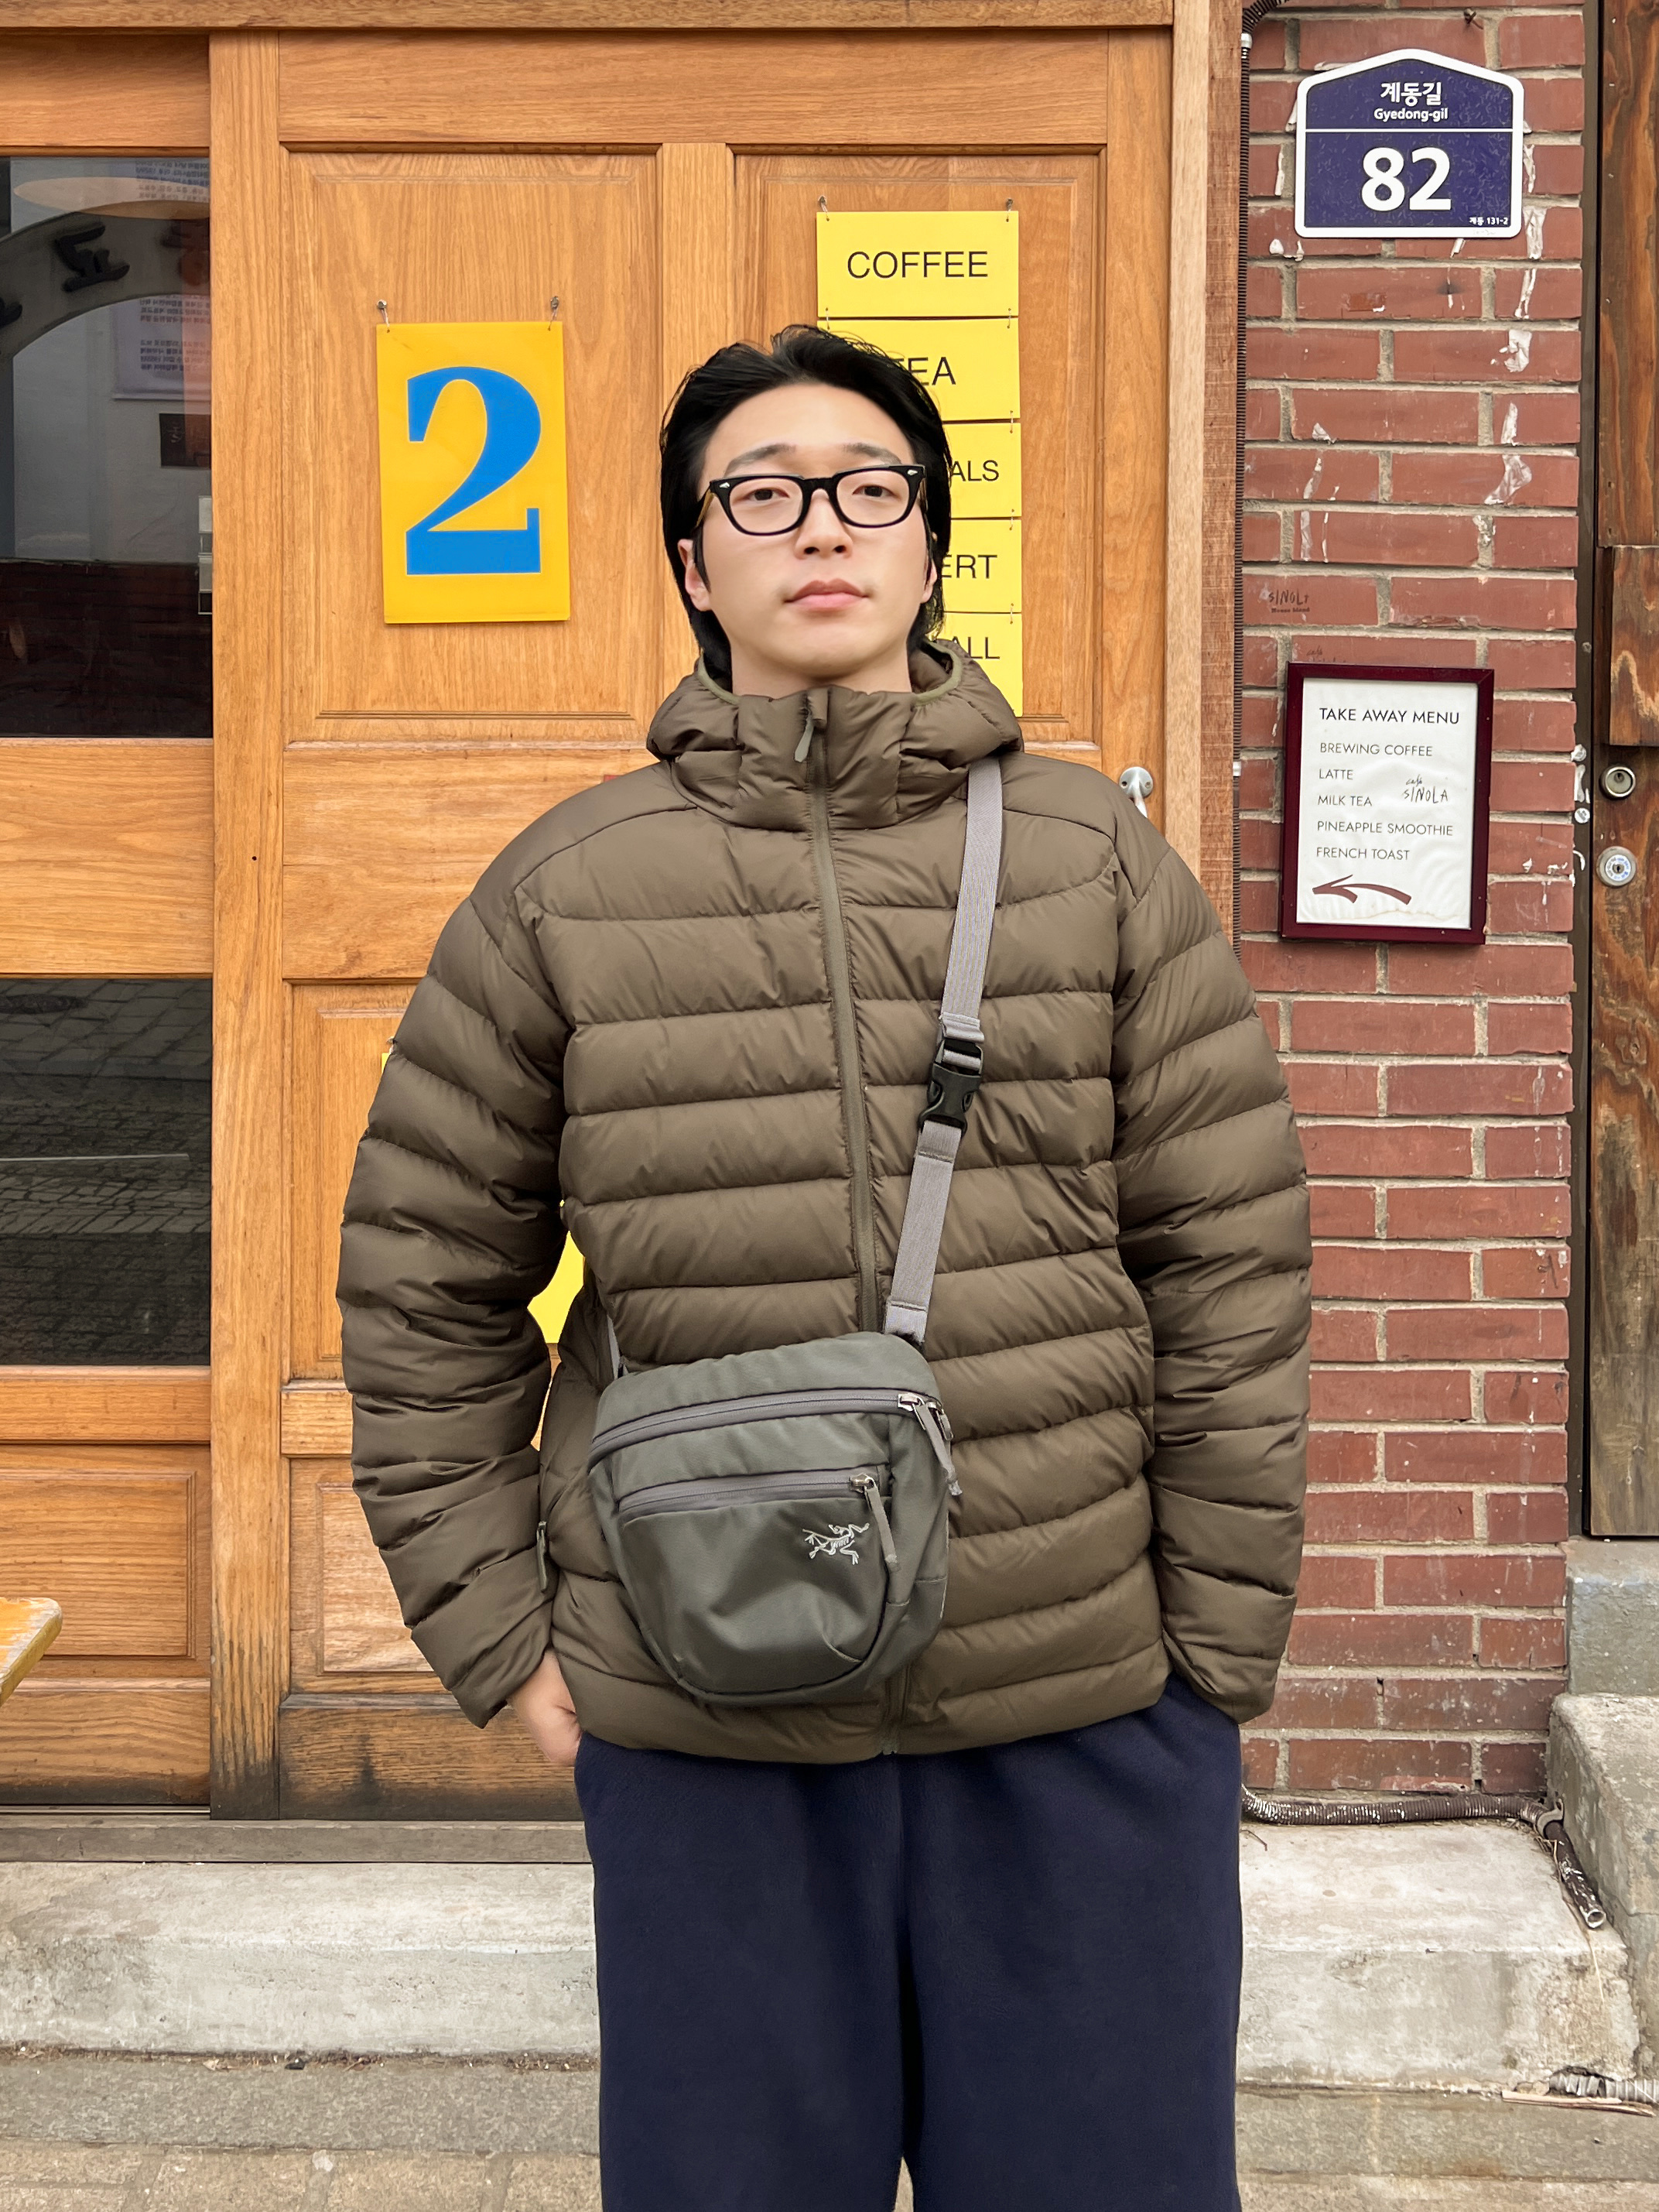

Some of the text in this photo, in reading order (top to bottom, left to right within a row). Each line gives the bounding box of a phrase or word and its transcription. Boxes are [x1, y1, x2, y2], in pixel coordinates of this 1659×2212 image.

[1380, 81, 1442, 106] 계동길
[1373, 108, 1449, 122] Gyedong-gil
[1361, 147, 1452, 211] 82
[1486, 217, 1509, 225] 131-2
[847, 251, 988, 279] COFFEE
[405, 366, 542, 575] 2
[951, 460, 1000, 482] ALS
[942, 554, 997, 579] ERT
[1319, 707, 1459, 724] TAKE AWAY MENU
[1320, 742, 1433, 756] BREWING COFFEE
[1319, 769, 1353, 780] LATTE
[1318, 795, 1373, 806] MILK TEA
[1403, 786, 1449, 803] SINOLA
[1317, 820, 1453, 836] PINEAPPLE SMOOTHIE
[1316, 847, 1410, 861] FRENCH TOAST
